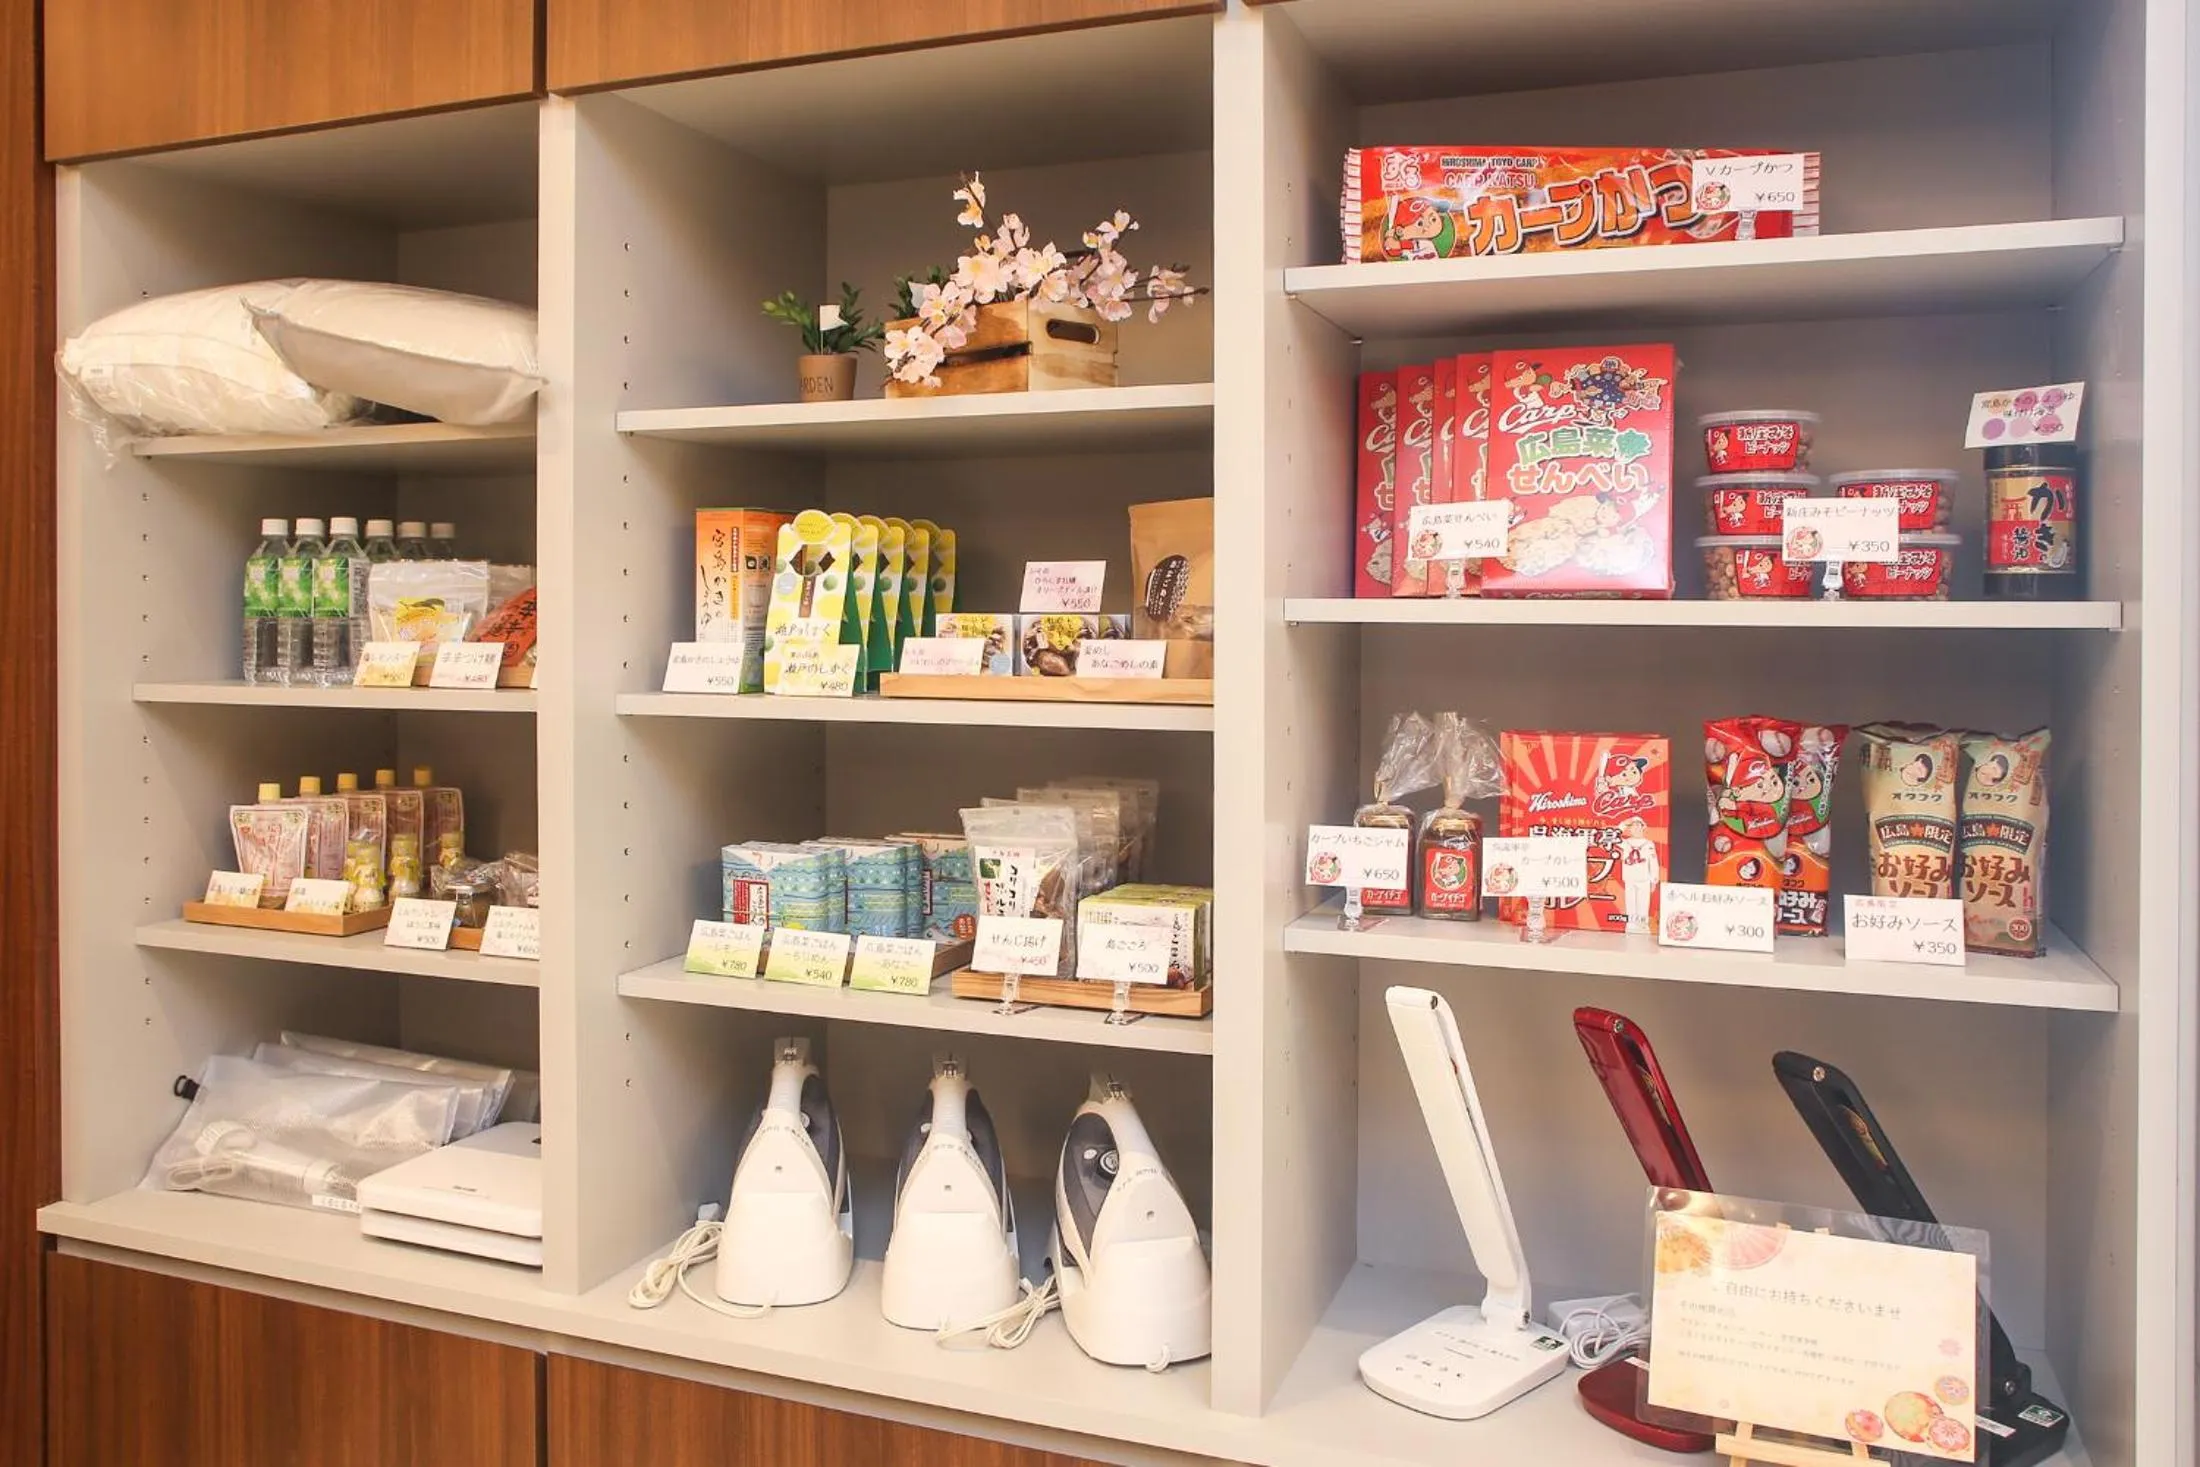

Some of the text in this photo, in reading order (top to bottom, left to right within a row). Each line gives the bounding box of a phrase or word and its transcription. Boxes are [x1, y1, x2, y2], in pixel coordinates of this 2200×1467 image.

[1754, 191, 1796, 203] ¥650
[1467, 163, 1699, 256] カープかつ
[1498, 402, 1577, 433] Carp
[1737, 426, 1794, 441] 新庄みそ
[1516, 428, 1616, 466] 広島菜
[1745, 441, 1790, 455] ピーナッツ
[1507, 462, 1649, 495] せんべい
[1463, 537, 1501, 550] ¥540
[1849, 539, 1890, 553] ¥350
[1529, 791, 1588, 812] Hiroshima
[1593, 791, 1655, 818] Carp
[1892, 791, 1943, 803] オタフク
[1968, 791, 2018, 803] オタフク
[1882, 823, 1910, 841] 広島
[2000, 825, 2029, 847] 限定
[1362, 867, 1401, 881] ¥650
[1541, 875, 1580, 889] ¥500
[1965, 879, 2017, 908] ソース
[1851, 911, 1959, 933] お好みソース
[1725, 924, 1765, 938] ¥300
[1912, 939, 1958, 955] ¥350
[1128, 961, 1160, 973] ¥500
[1709, 1280, 1902, 1321] 自由にお持ちくださいませ
